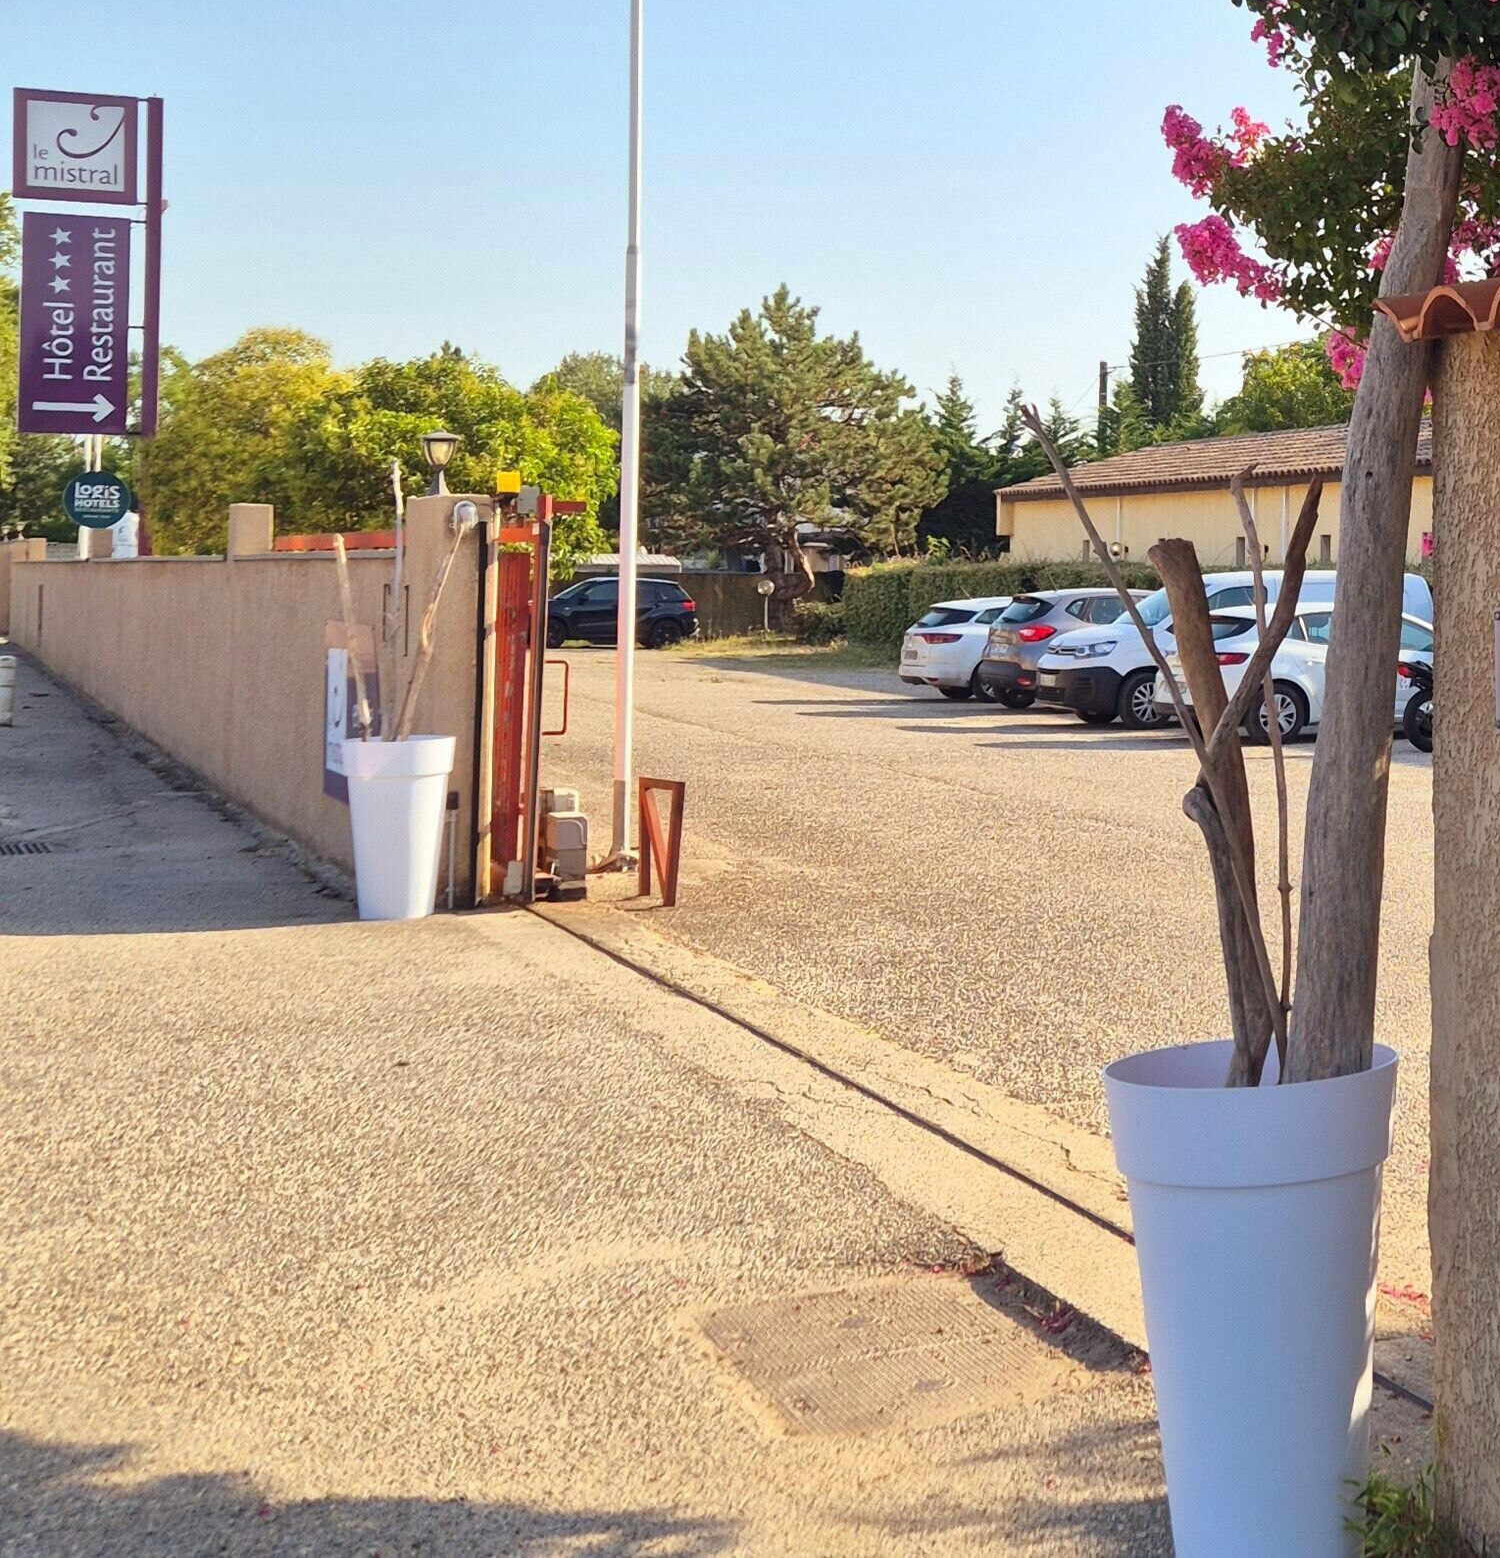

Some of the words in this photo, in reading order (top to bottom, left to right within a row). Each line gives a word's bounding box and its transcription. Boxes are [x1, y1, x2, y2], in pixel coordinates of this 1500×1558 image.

[33, 143, 49, 160] le
[34, 161, 118, 185] mistral
[83, 227, 116, 382] Restaurant
[41, 302, 75, 380] Hôtel
[74, 499, 121, 508] HOTELS
